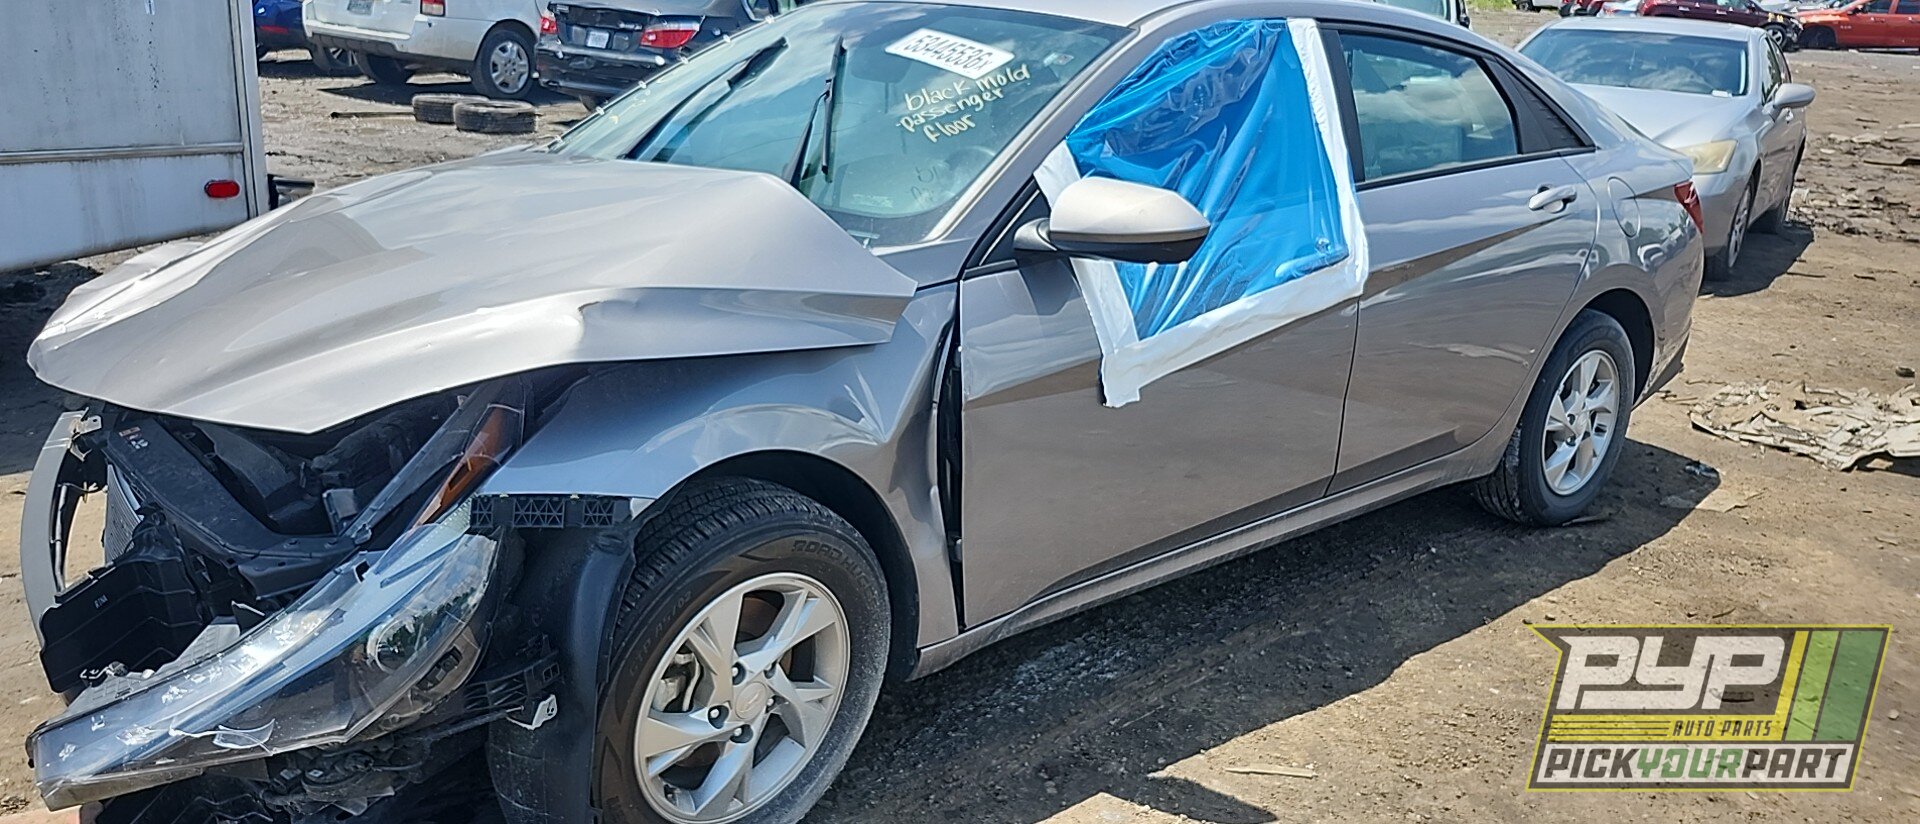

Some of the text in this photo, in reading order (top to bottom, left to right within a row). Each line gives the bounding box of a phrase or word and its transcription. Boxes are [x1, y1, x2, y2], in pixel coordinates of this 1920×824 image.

[899, 87, 1003, 132] passenger
[905, 63, 1030, 111] black mold
[923, 114, 976, 143] floor
